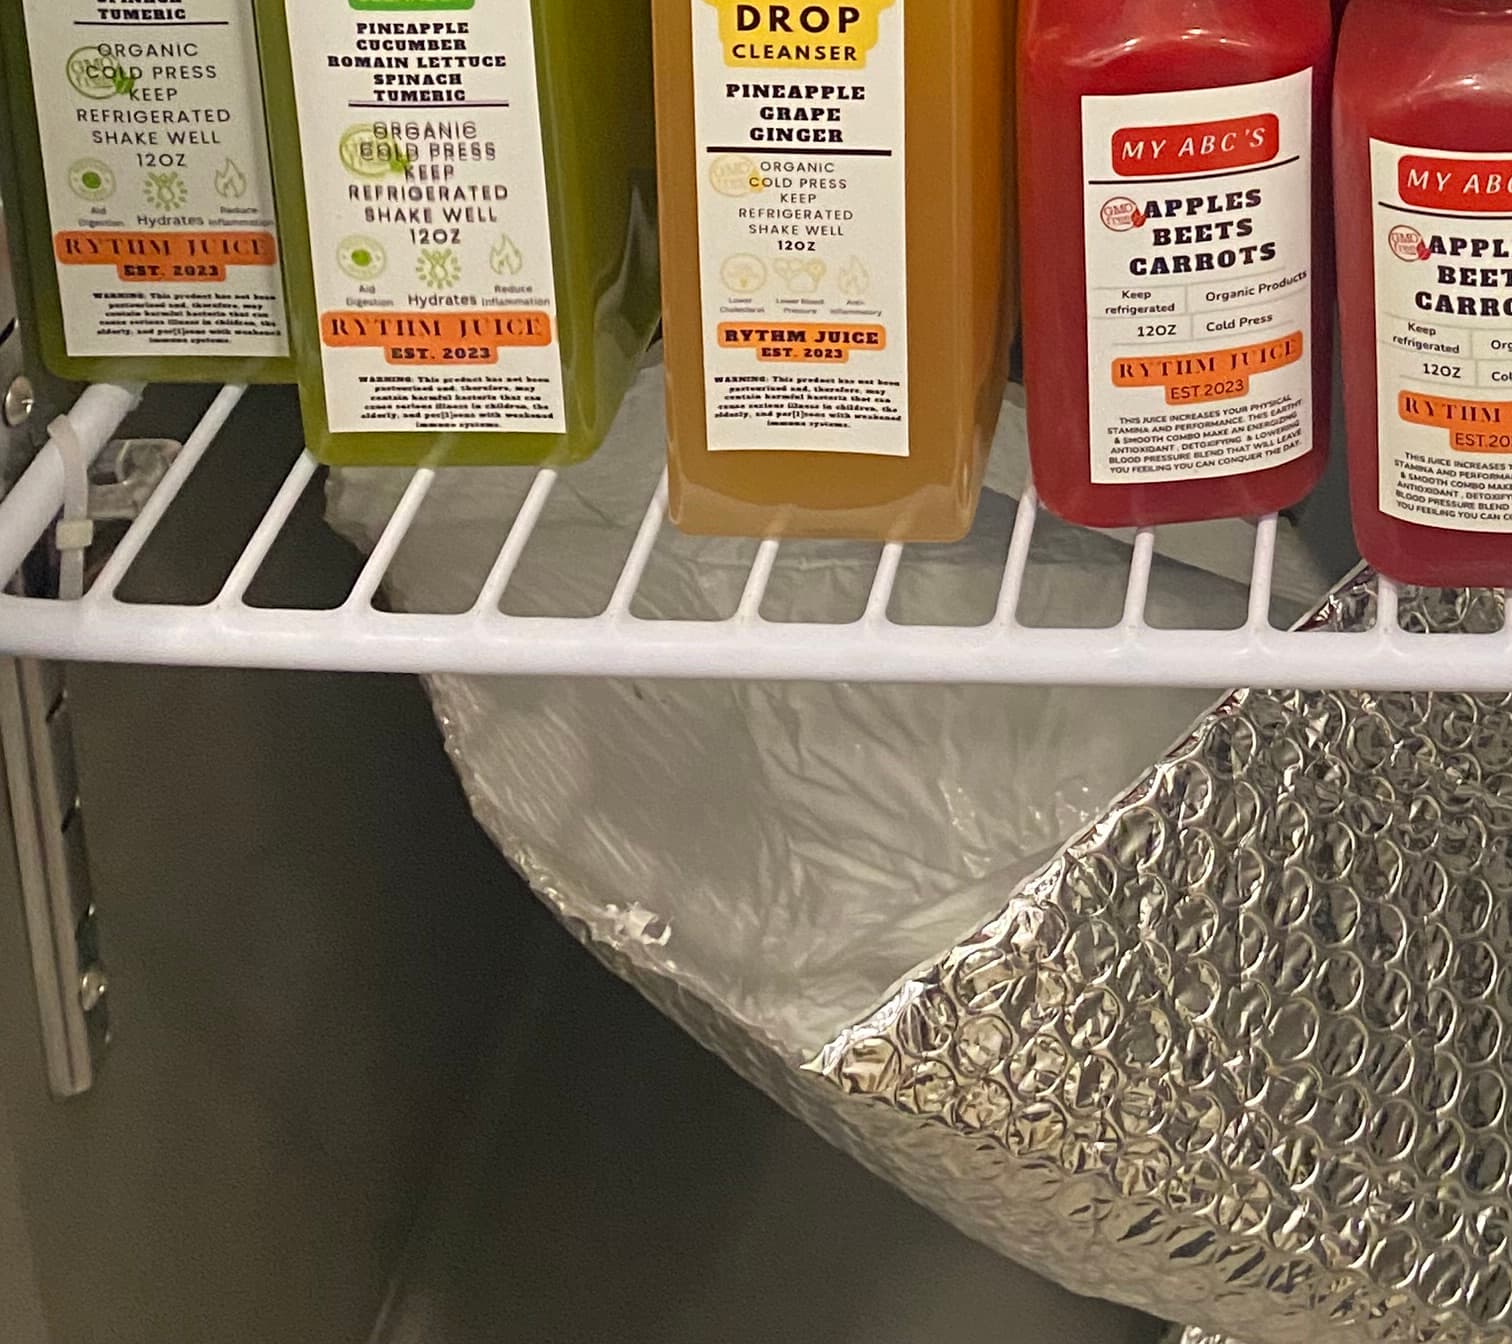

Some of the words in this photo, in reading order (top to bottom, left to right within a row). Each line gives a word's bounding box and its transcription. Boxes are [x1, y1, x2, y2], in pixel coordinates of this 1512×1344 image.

[737, 5, 860, 33] DROP
[732, 44, 857, 61] CLEANSER
[374, 90, 466, 102] TUMERIC
[726, 84, 865, 100] PINEAPPLE
[77, 109, 231, 124] REFRIGERATED
[760, 107, 841, 122] GRAPE
[749, 128, 844, 143] GINGER
[1122, 140, 1167, 160] MY
[1178, 127, 1266, 157] ABC'S
[137, 154, 187, 167] 12OZ
[749, 177, 792, 188] COLD
[800, 178, 847, 189] PRESS
[1407, 169, 1451, 192] MY
[1144, 189, 1261, 219] APPLES
[137, 215, 203, 227] Hydrates
[1152, 218, 1253, 246] BEETS
[777, 240, 816, 252] 12OZ
[1129, 242, 1276, 276] CARROTS
[1205, 287, 1255, 303] Organic
[1258, 270, 1308, 293] Products
[1122, 290, 1151, 301] Keep
[1105, 303, 1175, 315] refrigerated
[332, 320, 441, 336] RYTHM
[460, 319, 542, 338] JUICE
[725, 330, 806, 343] RYTHM
[814, 331, 879, 344] JUICE
[1423, 364, 1461, 379] 12OZ
